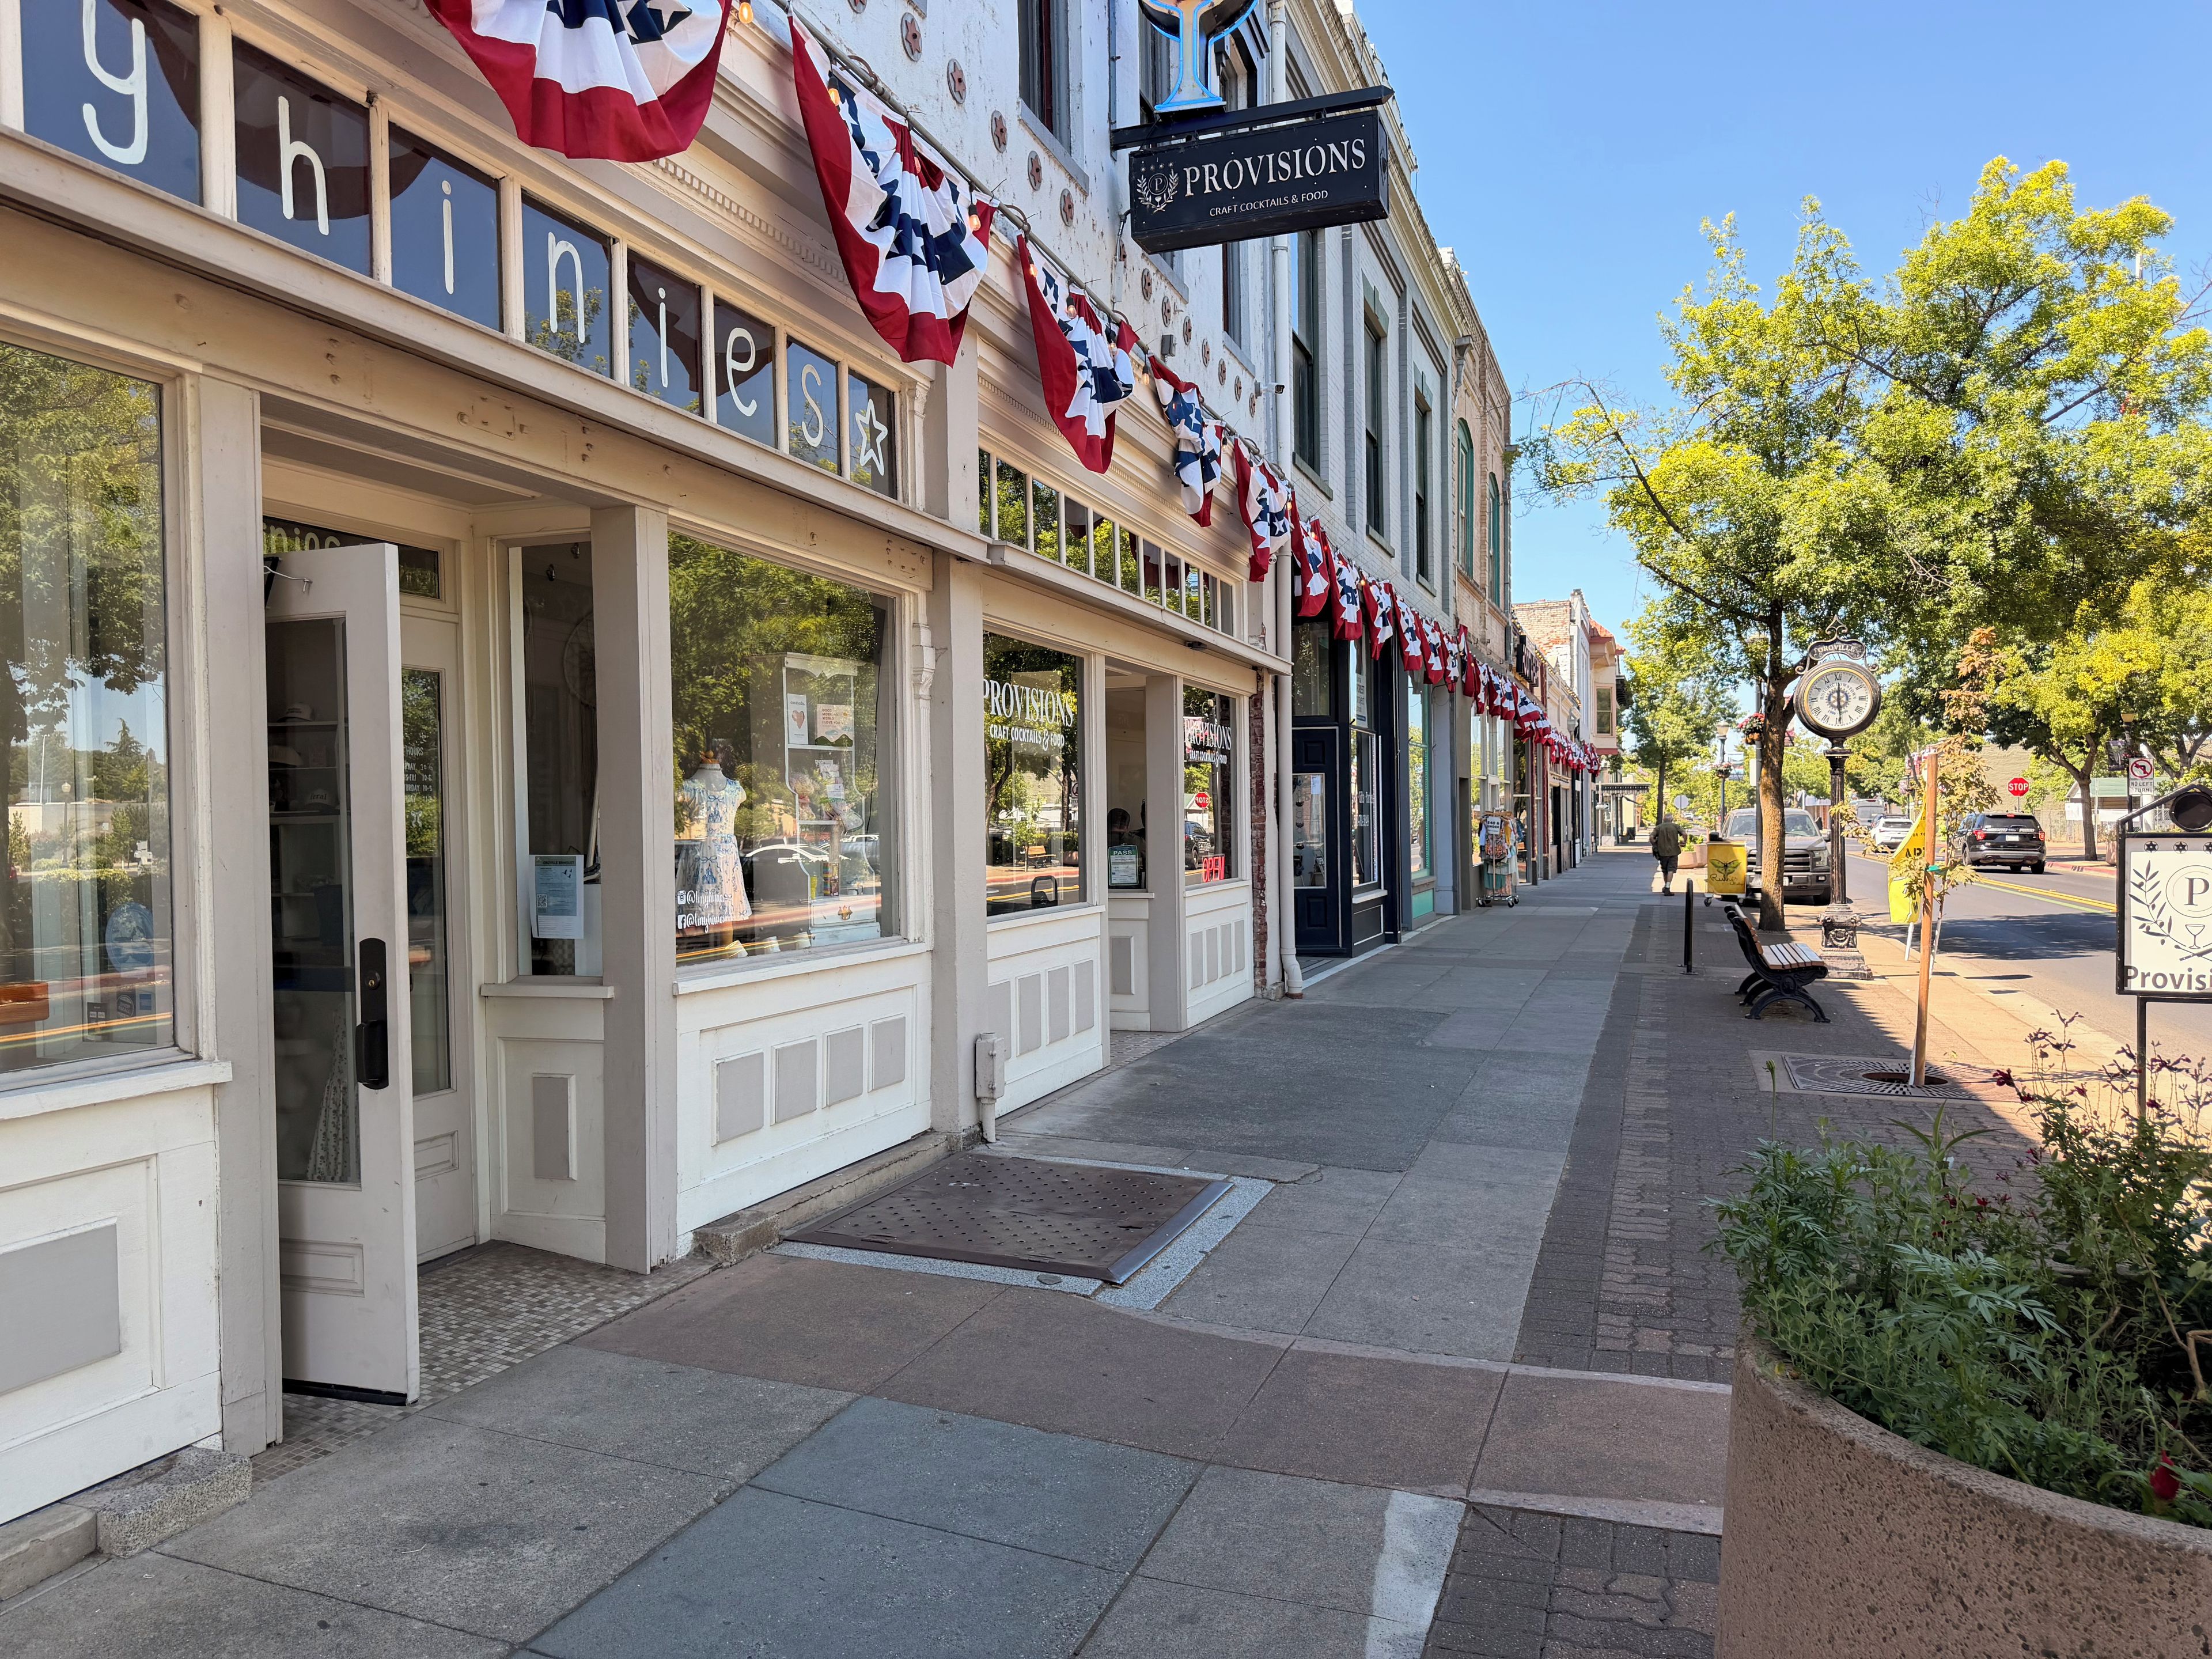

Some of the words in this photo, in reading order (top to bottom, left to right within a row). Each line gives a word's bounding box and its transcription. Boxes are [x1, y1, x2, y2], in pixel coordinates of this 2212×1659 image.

[1183, 138, 1366, 197] PROVISIONS
[1209, 203, 1238, 217] CRAFT
[1240, 195, 1289, 213] COCKTAILS
[1291, 194, 1299, 203] &
[1301, 190, 1328, 202] FOOD
[1818, 644, 1855, 653] OROVILLE
[983, 679, 1074, 727] PROVISIONS
[1820, 683, 1835, 700] HISTORIC
[990, 724, 1009, 740] CRAFT
[1011, 727, 1042, 744] COCKTAILS
[1042, 728, 1050, 751] &
[1050, 733, 1065, 747] FOOD
[1184, 718, 1232, 750] PROVISIONS
[1190, 749, 1199, 760] CRAFT
[1200, 751, 1215, 763] COCKTAILS
[1219, 754, 1228, 764] FOOD
[2009, 783, 2028, 791] STOP
[1202, 856, 1225, 882] OPEN
[2184, 877, 2210, 906] P
